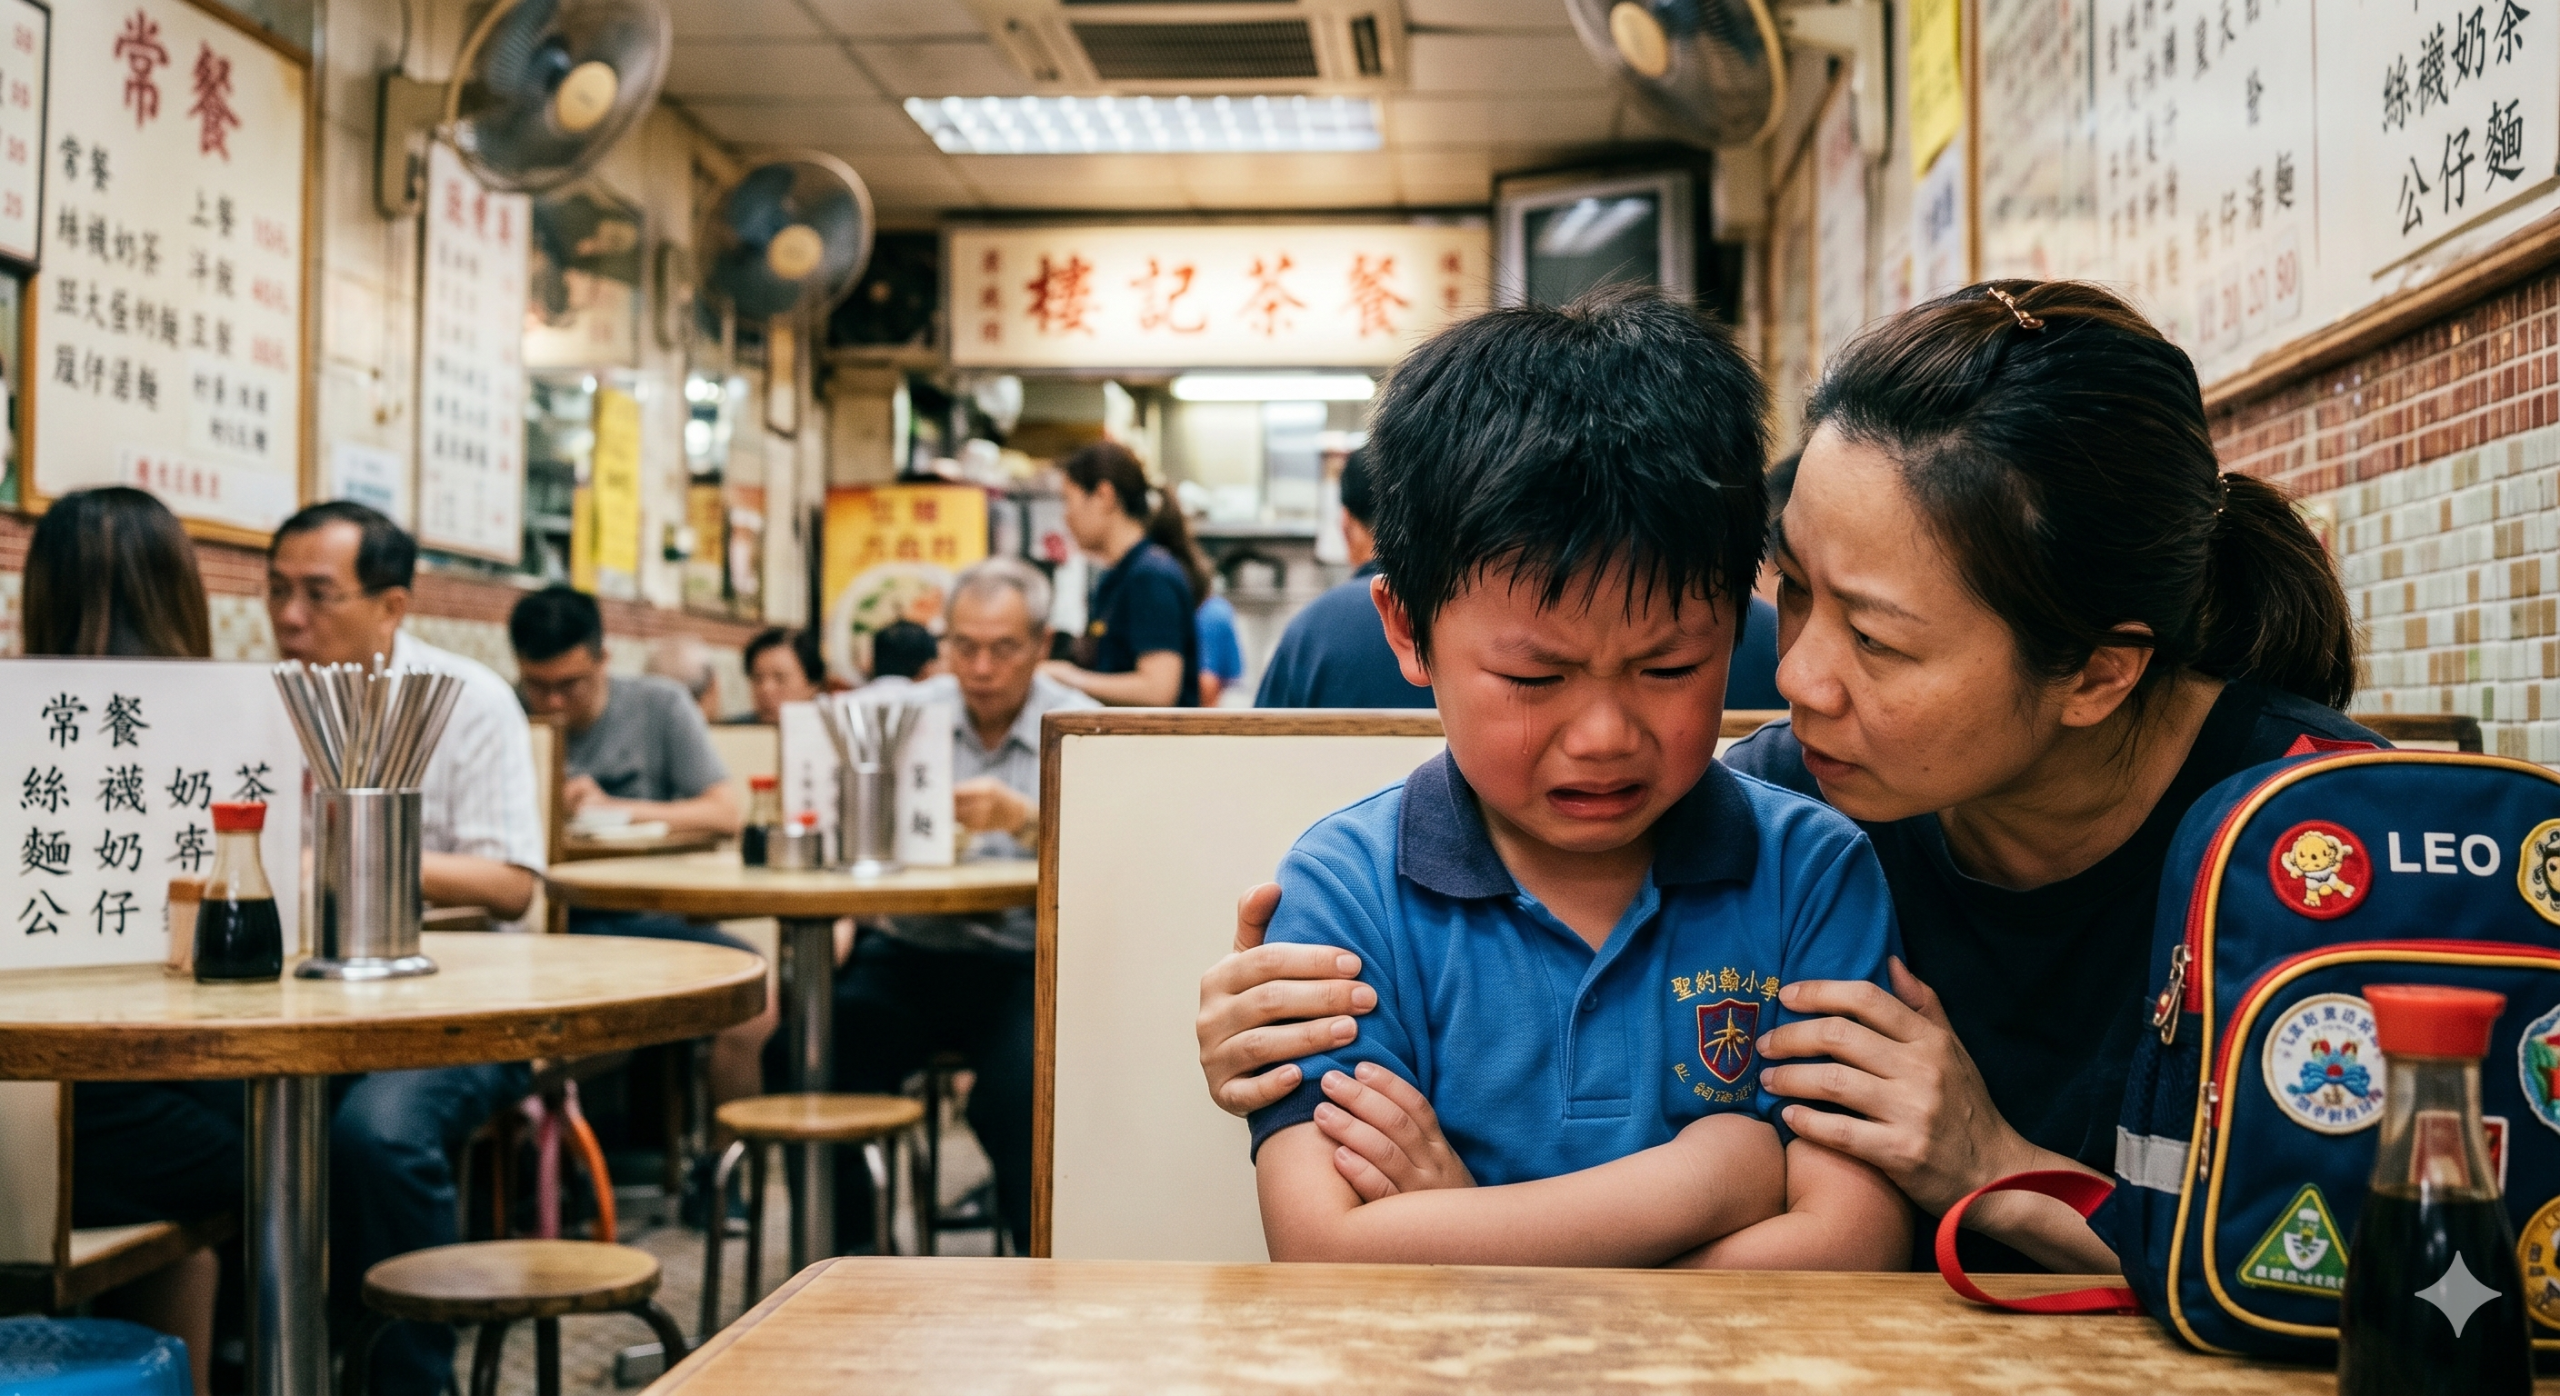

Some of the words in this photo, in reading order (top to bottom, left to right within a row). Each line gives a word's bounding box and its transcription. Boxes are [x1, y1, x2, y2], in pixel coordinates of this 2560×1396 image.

[113, 8, 241, 163] 常餐
[2397, 98, 2526, 237] 公仔麵
[1024, 250, 1410, 338] 樓記茶餐
[41, 692, 151, 749] 常餐
[19, 762, 278, 816] 絲襪奶茶
[2386, 831, 2501, 877] LEO
[1670, 966, 1780, 1002] 聖約翰小學
